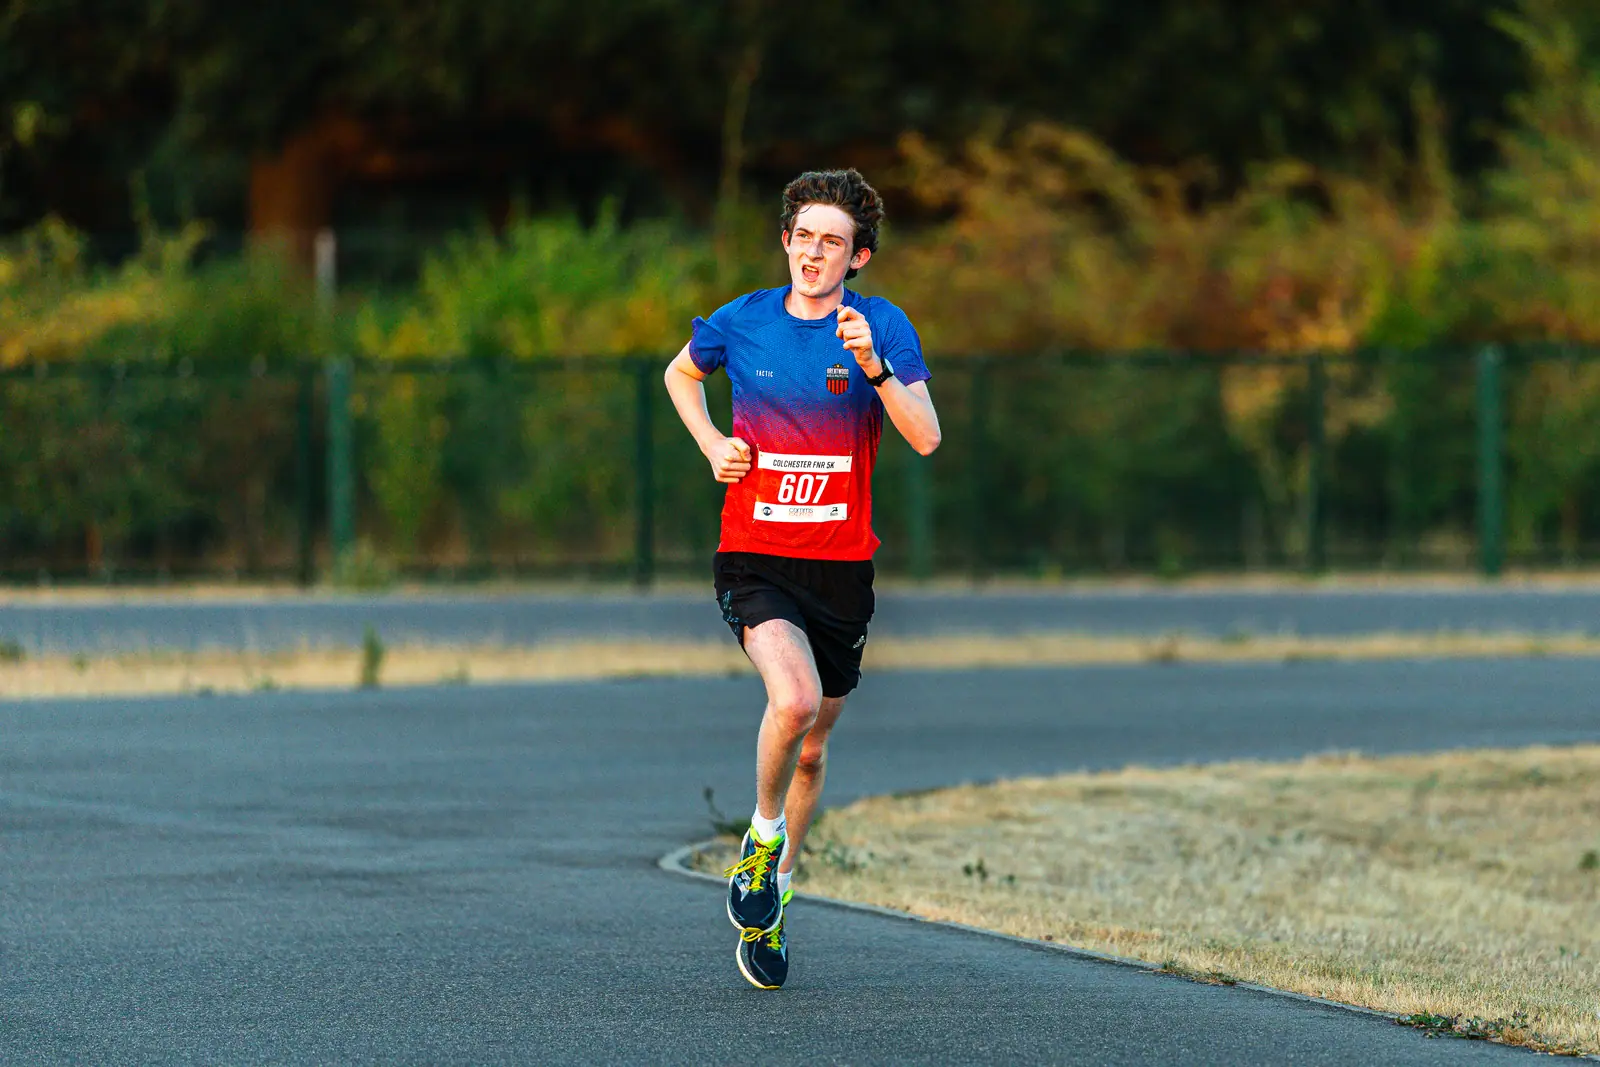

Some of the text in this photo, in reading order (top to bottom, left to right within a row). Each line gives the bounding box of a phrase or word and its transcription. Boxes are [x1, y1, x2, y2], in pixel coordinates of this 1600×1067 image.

[756, 369, 773, 378] TACTIC
[772, 459, 835, 469] COLCHESTER FNR 5K
[777, 473, 829, 504] 607
